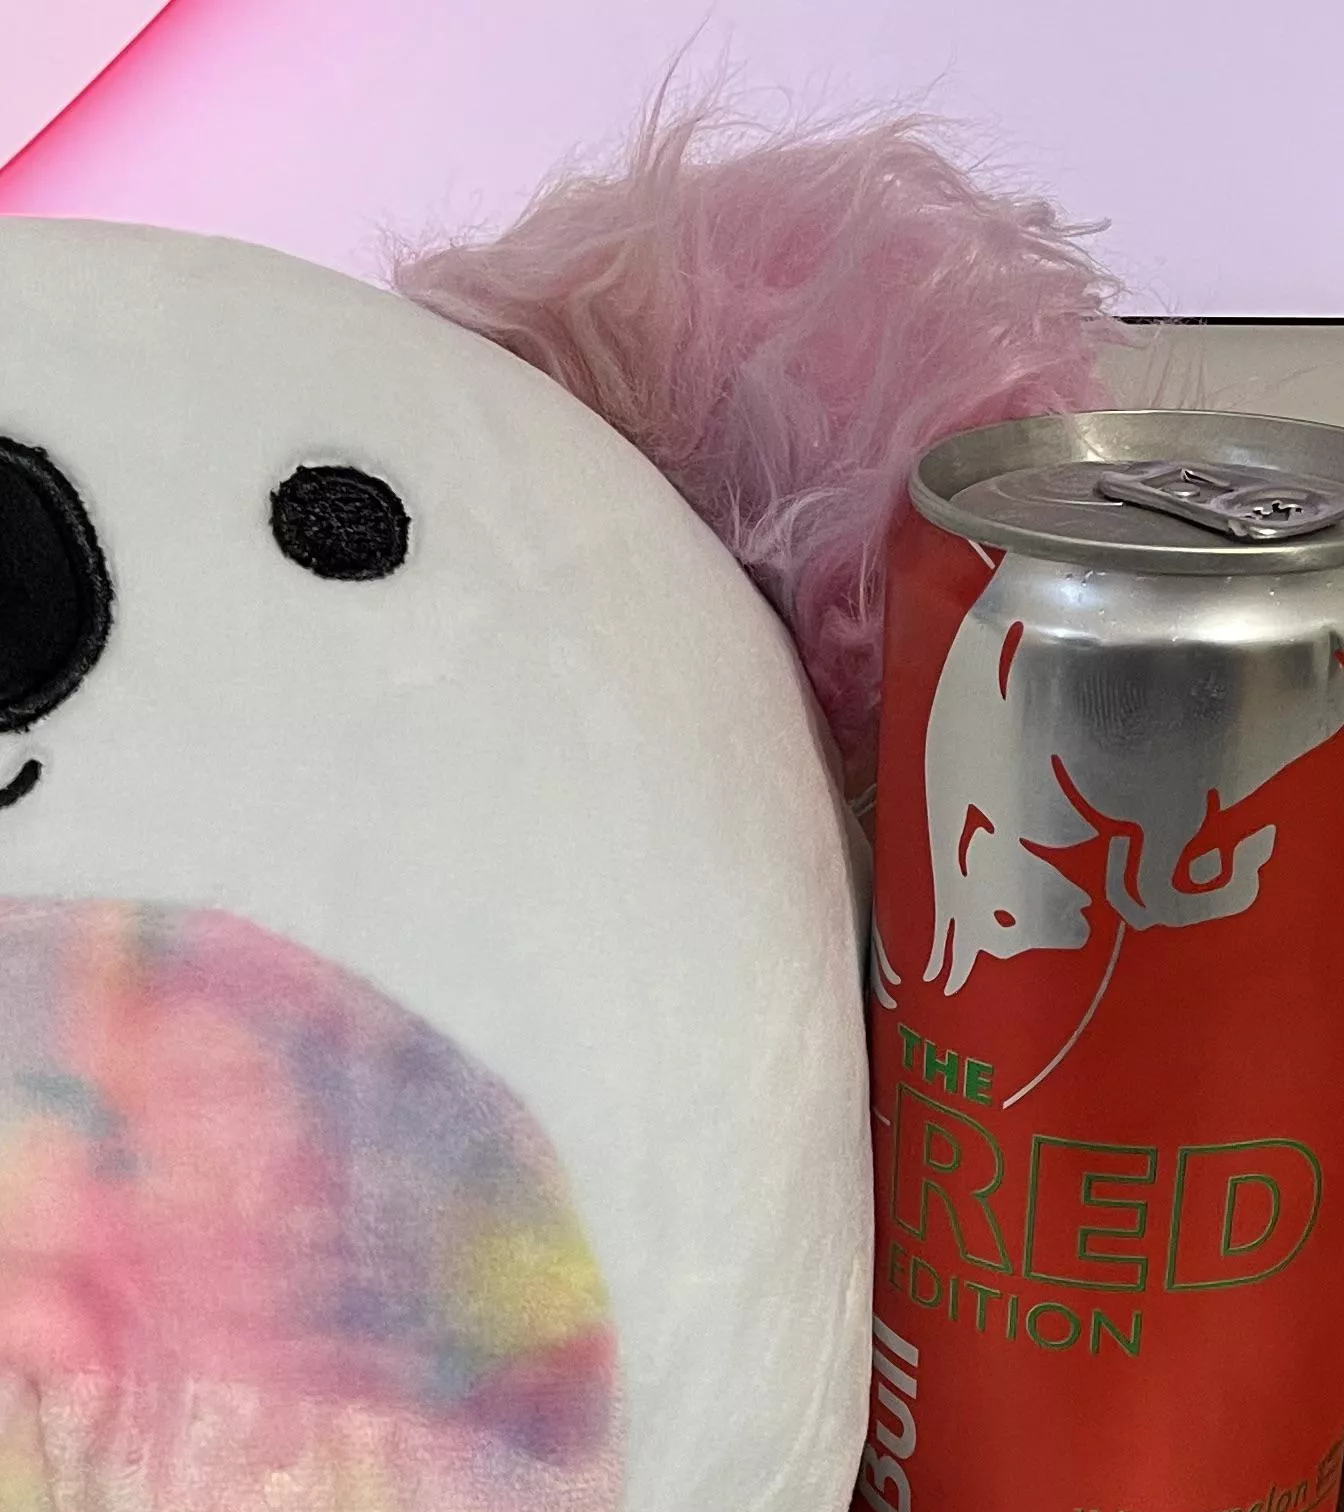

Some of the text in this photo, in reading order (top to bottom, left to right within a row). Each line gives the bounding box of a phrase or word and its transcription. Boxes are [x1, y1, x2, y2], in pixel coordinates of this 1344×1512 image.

[898, 1023, 994, 1105] THE
[891, 1083, 1323, 1292] RED
[887, 1240, 1143, 1357] EDITION
